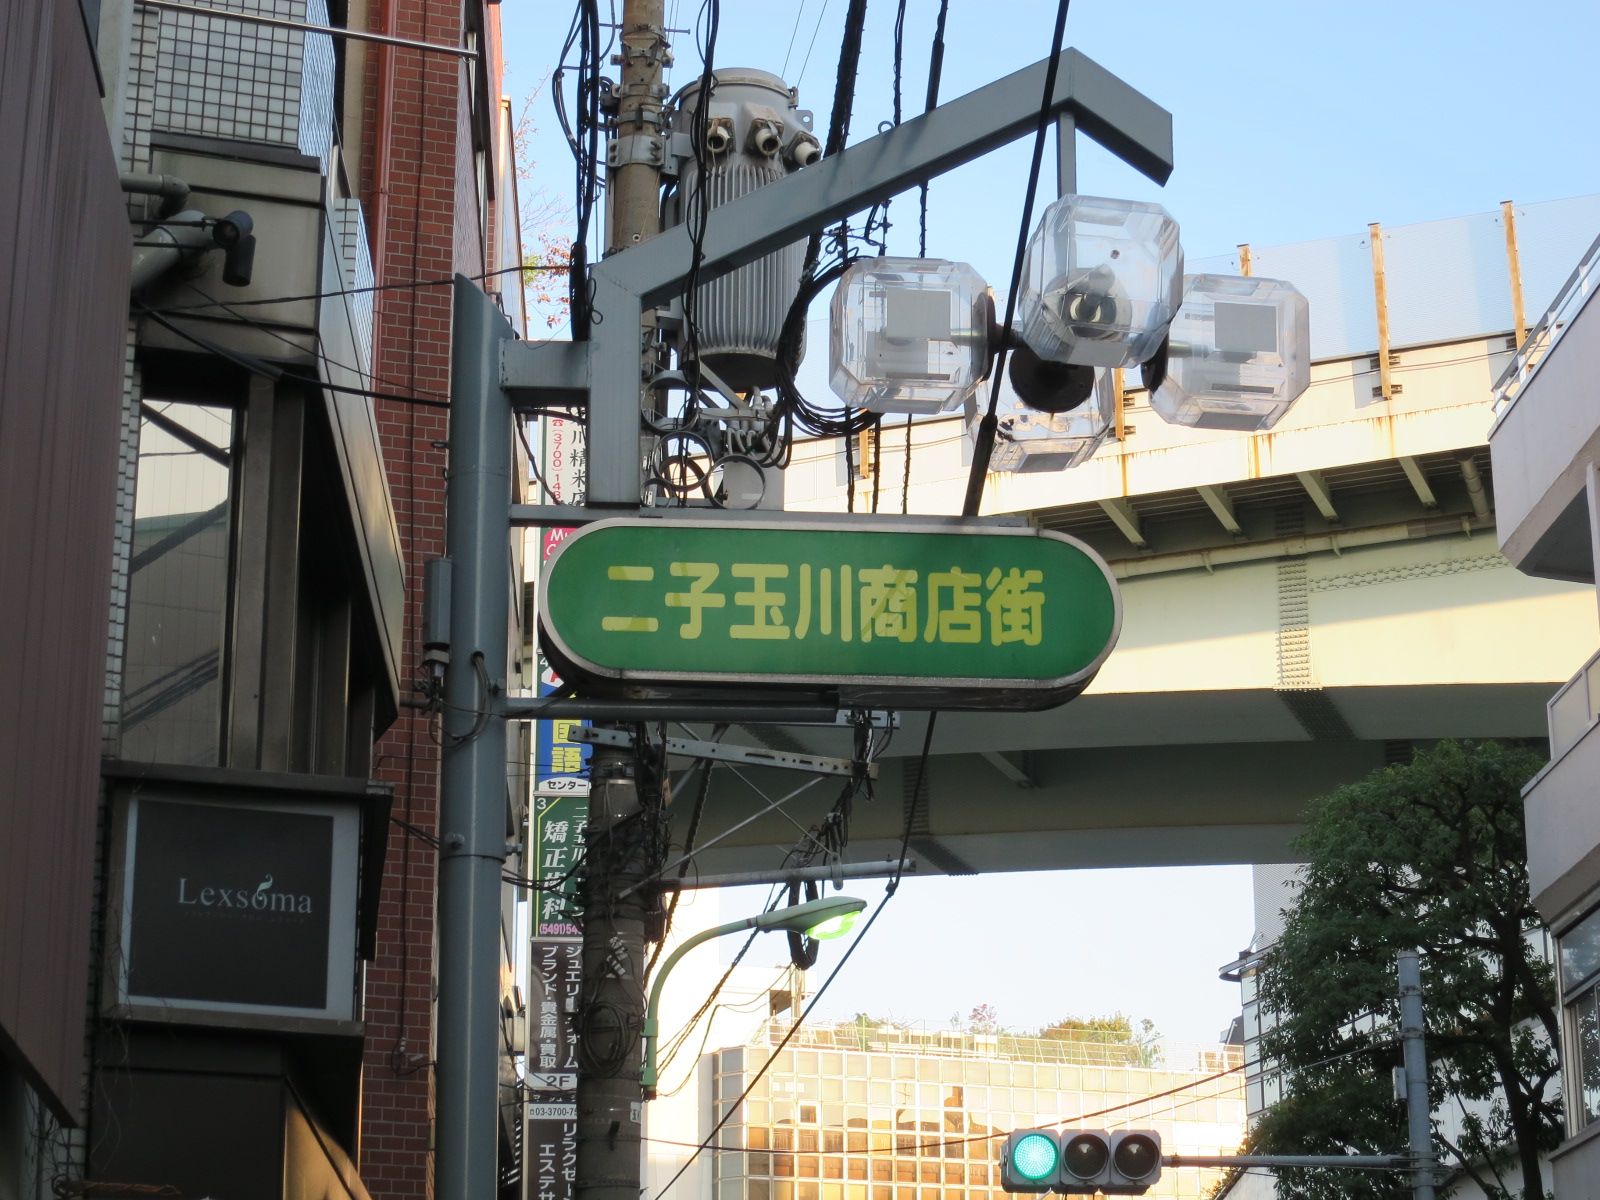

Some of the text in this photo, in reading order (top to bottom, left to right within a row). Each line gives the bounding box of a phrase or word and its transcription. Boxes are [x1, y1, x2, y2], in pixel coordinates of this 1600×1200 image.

[601, 561, 1046, 647] 二子玉川商店街
[547, 780, 587, 790] センター
[536, 798, 546, 810] 3
[541, 820, 569, 921] 矯正歯科
[178, 876, 313, 914] Lexsoma
[546, 1075, 570, 1087] 2F
